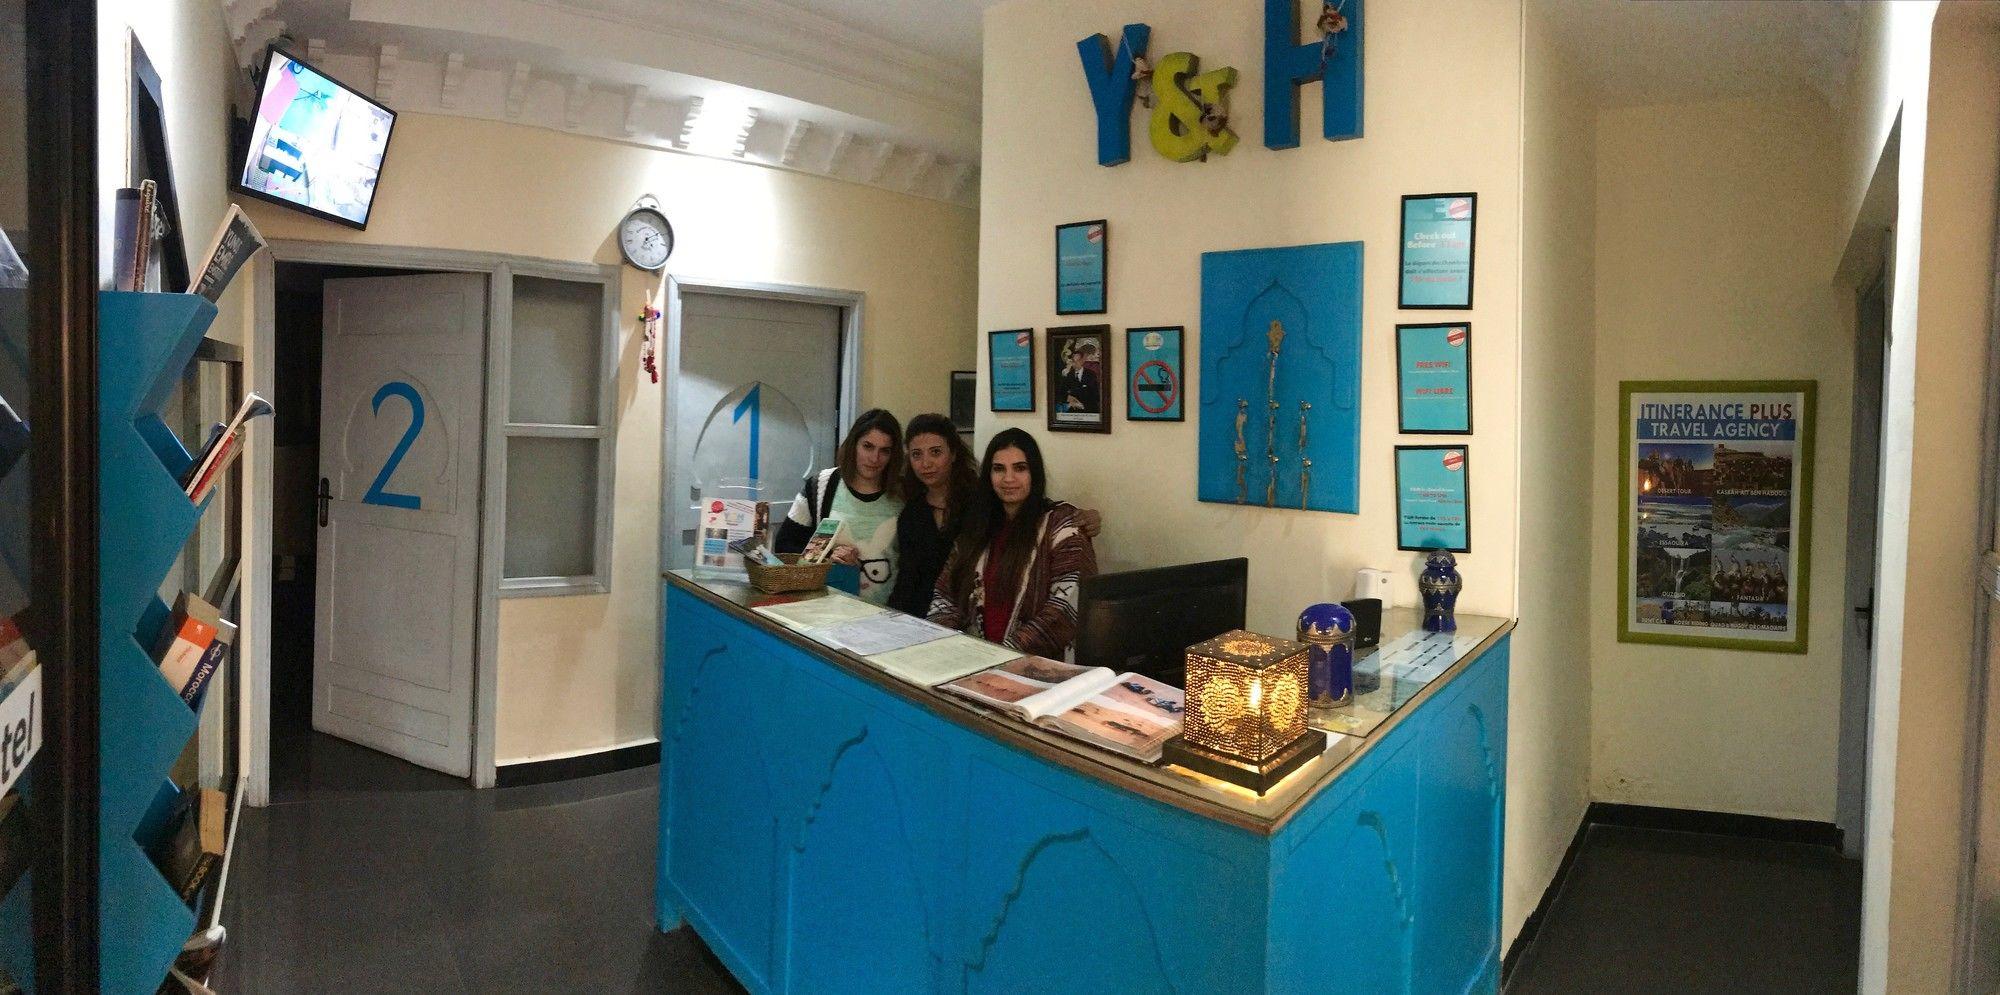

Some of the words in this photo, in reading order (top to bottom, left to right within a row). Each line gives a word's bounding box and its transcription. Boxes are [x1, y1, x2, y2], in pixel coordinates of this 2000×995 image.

[733, 382, 760, 500] 1
[1651, 422, 1708, 437] TRAVEL
[1713, 422, 1780, 437] AGENCY
[1750, 403, 1793, 420] PLUS
[361, 382, 425, 510] 2
